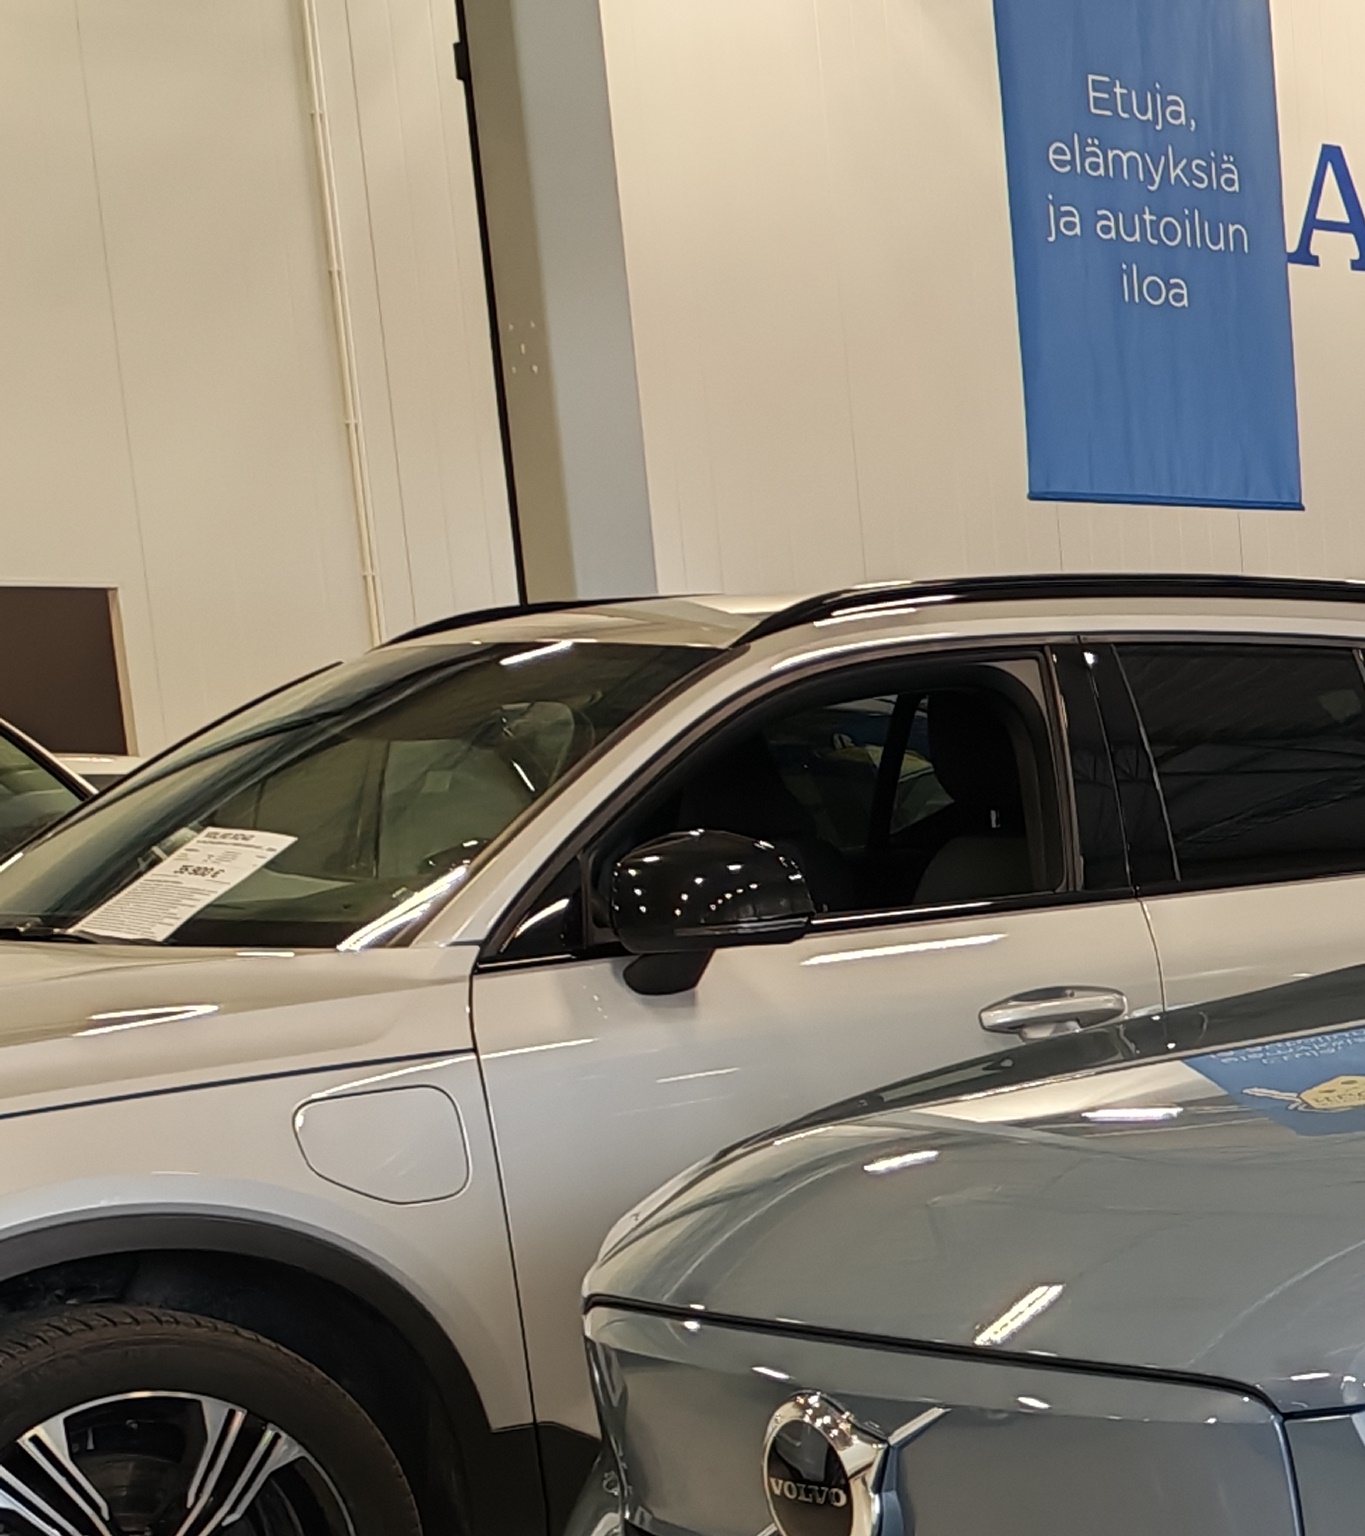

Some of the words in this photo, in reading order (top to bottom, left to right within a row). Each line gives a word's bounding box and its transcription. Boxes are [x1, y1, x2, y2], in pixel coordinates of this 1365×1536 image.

[1087, 74, 1196, 132] Etuja,
[1048, 132, 1240, 194] elämyksiä
[1047, 193, 1081, 242] ja
[1096, 205, 1249, 254] autoilun
[1121, 262, 1189, 308] iloa
[769, 1476, 848, 1508] VOLVO
